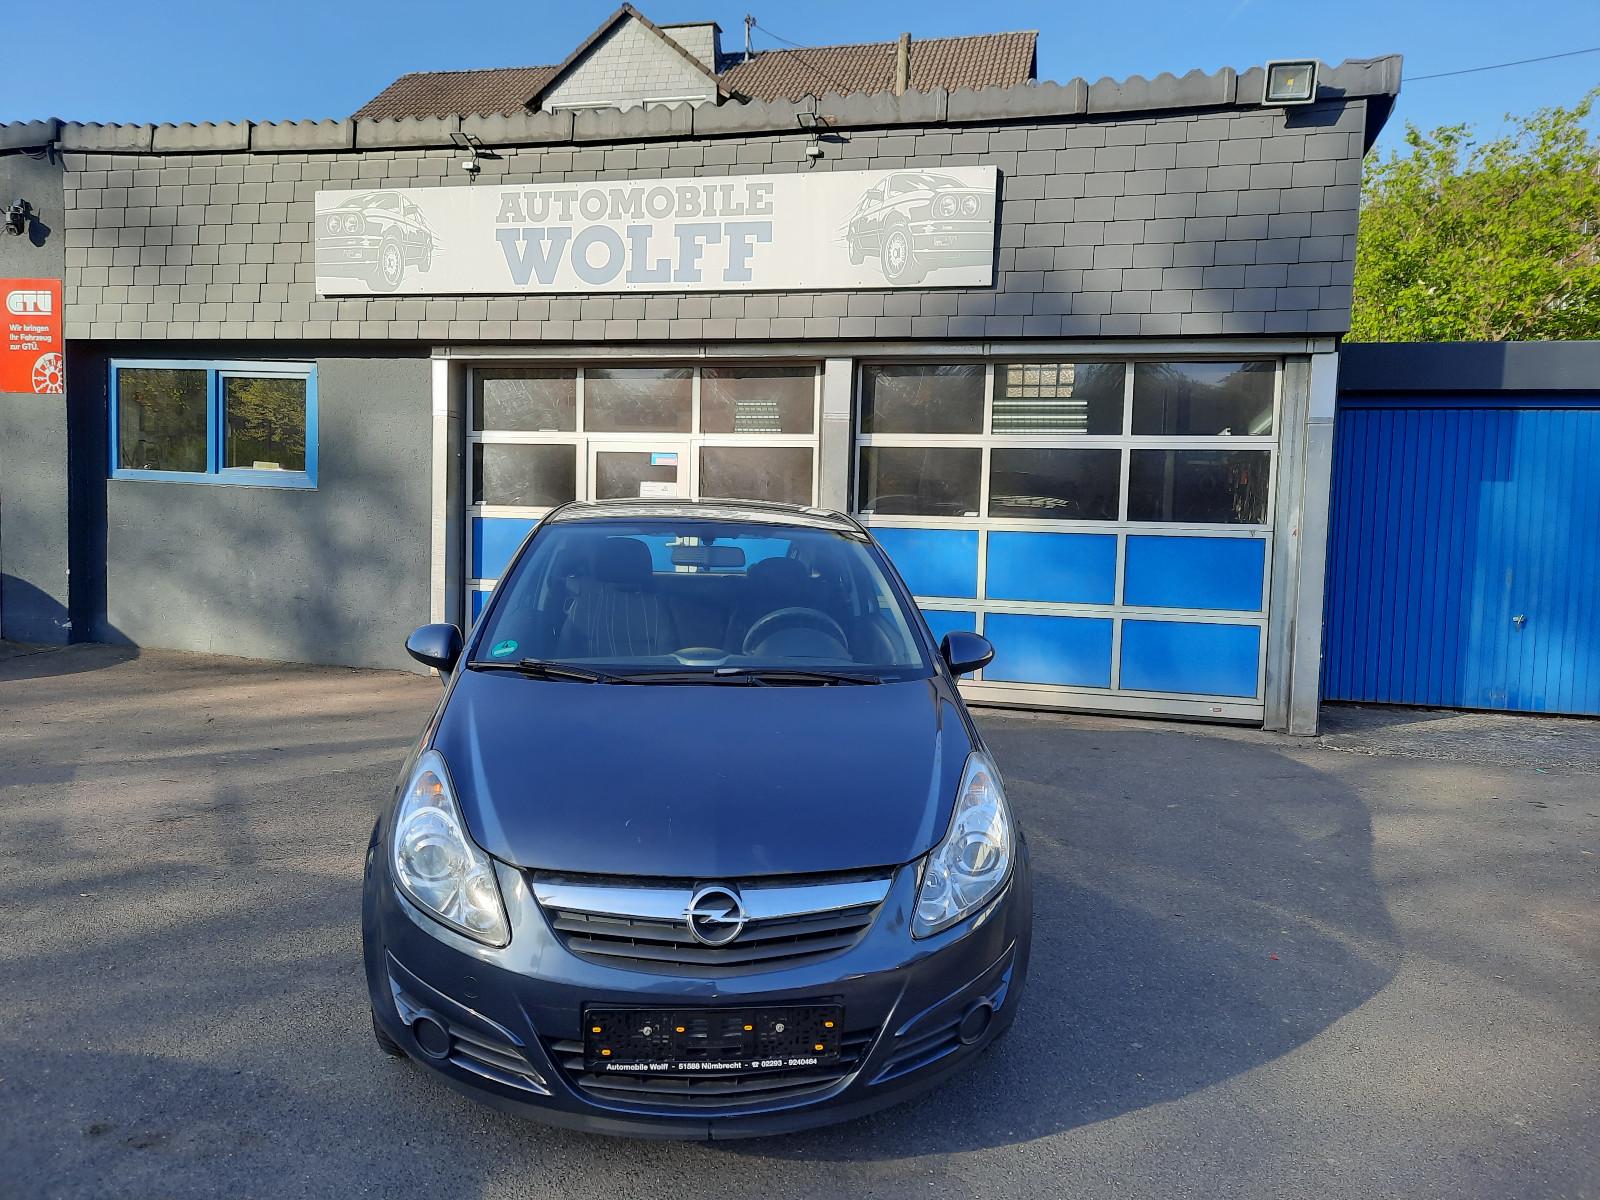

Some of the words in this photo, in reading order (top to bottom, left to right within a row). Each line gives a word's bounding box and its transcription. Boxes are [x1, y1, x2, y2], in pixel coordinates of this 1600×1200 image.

[496, 183, 774, 223] AUTOMOBILE
[496, 221, 773, 286] WOLFF
[23, 324, 49, 333] bringen
[10, 333, 20, 341] Ihr
[20, 334, 52, 343] Fahrzeug
[606, 1063, 649, 1071] Automobile
[649, 1063, 669, 1071] Wolff
[701, 1061, 742, 1070] Nümbrecht
[761, 1059, 783, 1068] 02293
